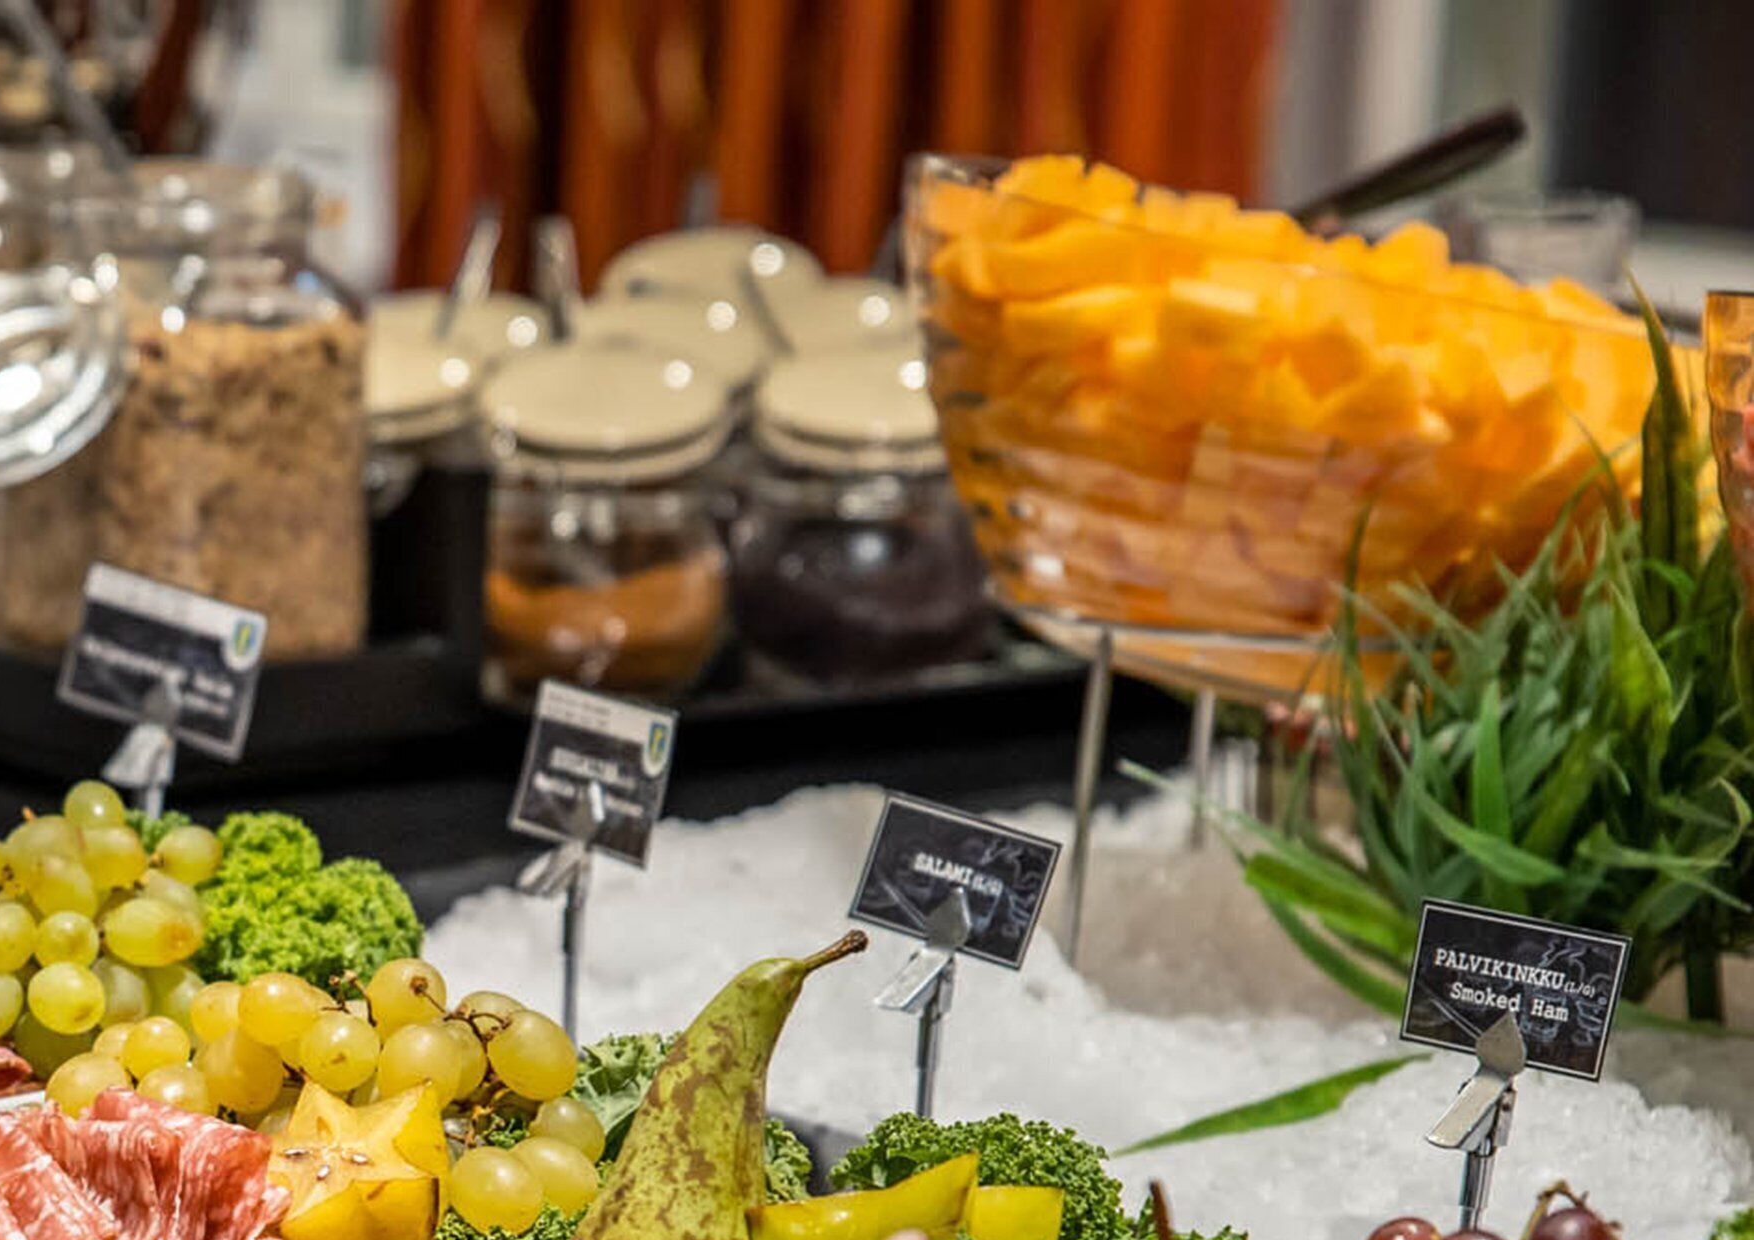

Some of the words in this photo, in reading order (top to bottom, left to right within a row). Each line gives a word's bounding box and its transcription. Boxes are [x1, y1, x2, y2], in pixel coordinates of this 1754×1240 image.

[914, 852, 974, 885] SALAMI
[1434, 948, 1566, 990] PALVIKINKKU
[1450, 981, 1521, 1012] Smoked
[1530, 998, 1569, 1022] Ham
